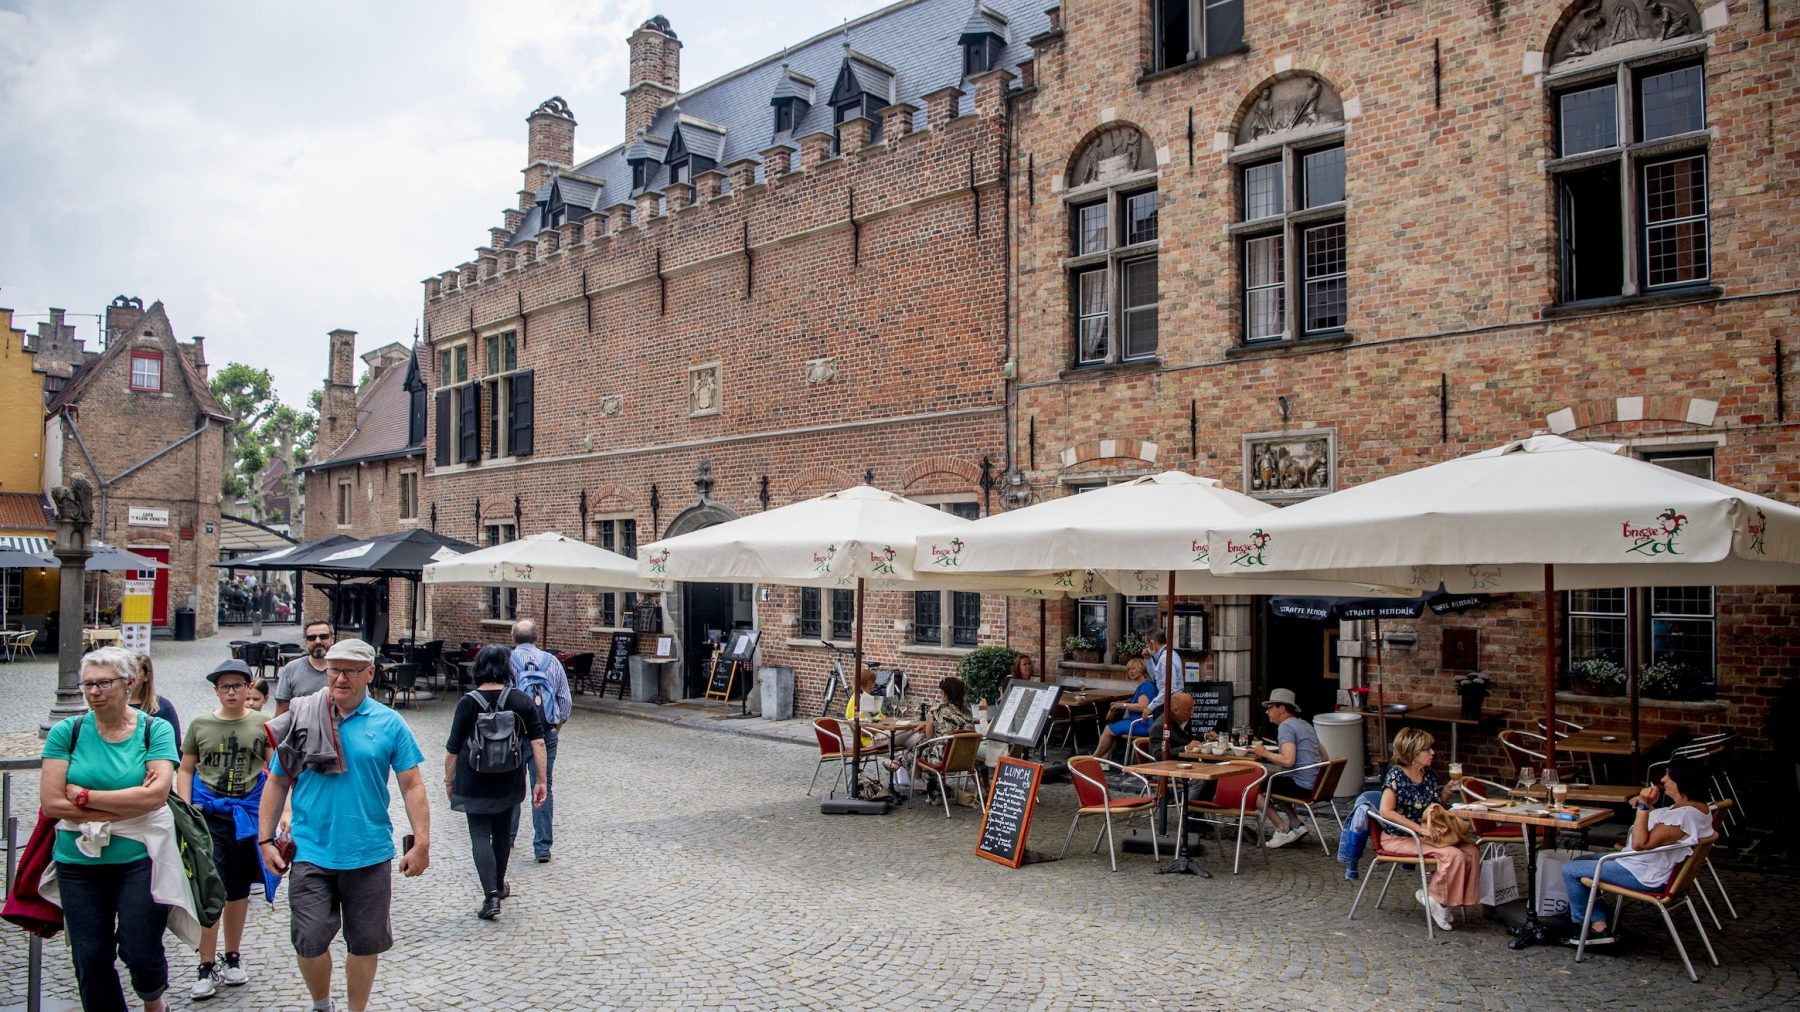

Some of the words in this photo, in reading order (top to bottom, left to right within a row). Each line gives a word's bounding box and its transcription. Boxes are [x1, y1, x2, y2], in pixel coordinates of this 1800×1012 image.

[1625, 536, 1685, 556] Zot
[1229, 551, 1270, 568] Zot
[1344, 609, 1376, 617] STRAFFE
[1379, 606, 1416, 616] HENDRIK
[204, 751, 231, 768] NOT
[1004, 766, 1031, 781] LUNCH
[1495, 885, 1517, 902] ESPRIT
